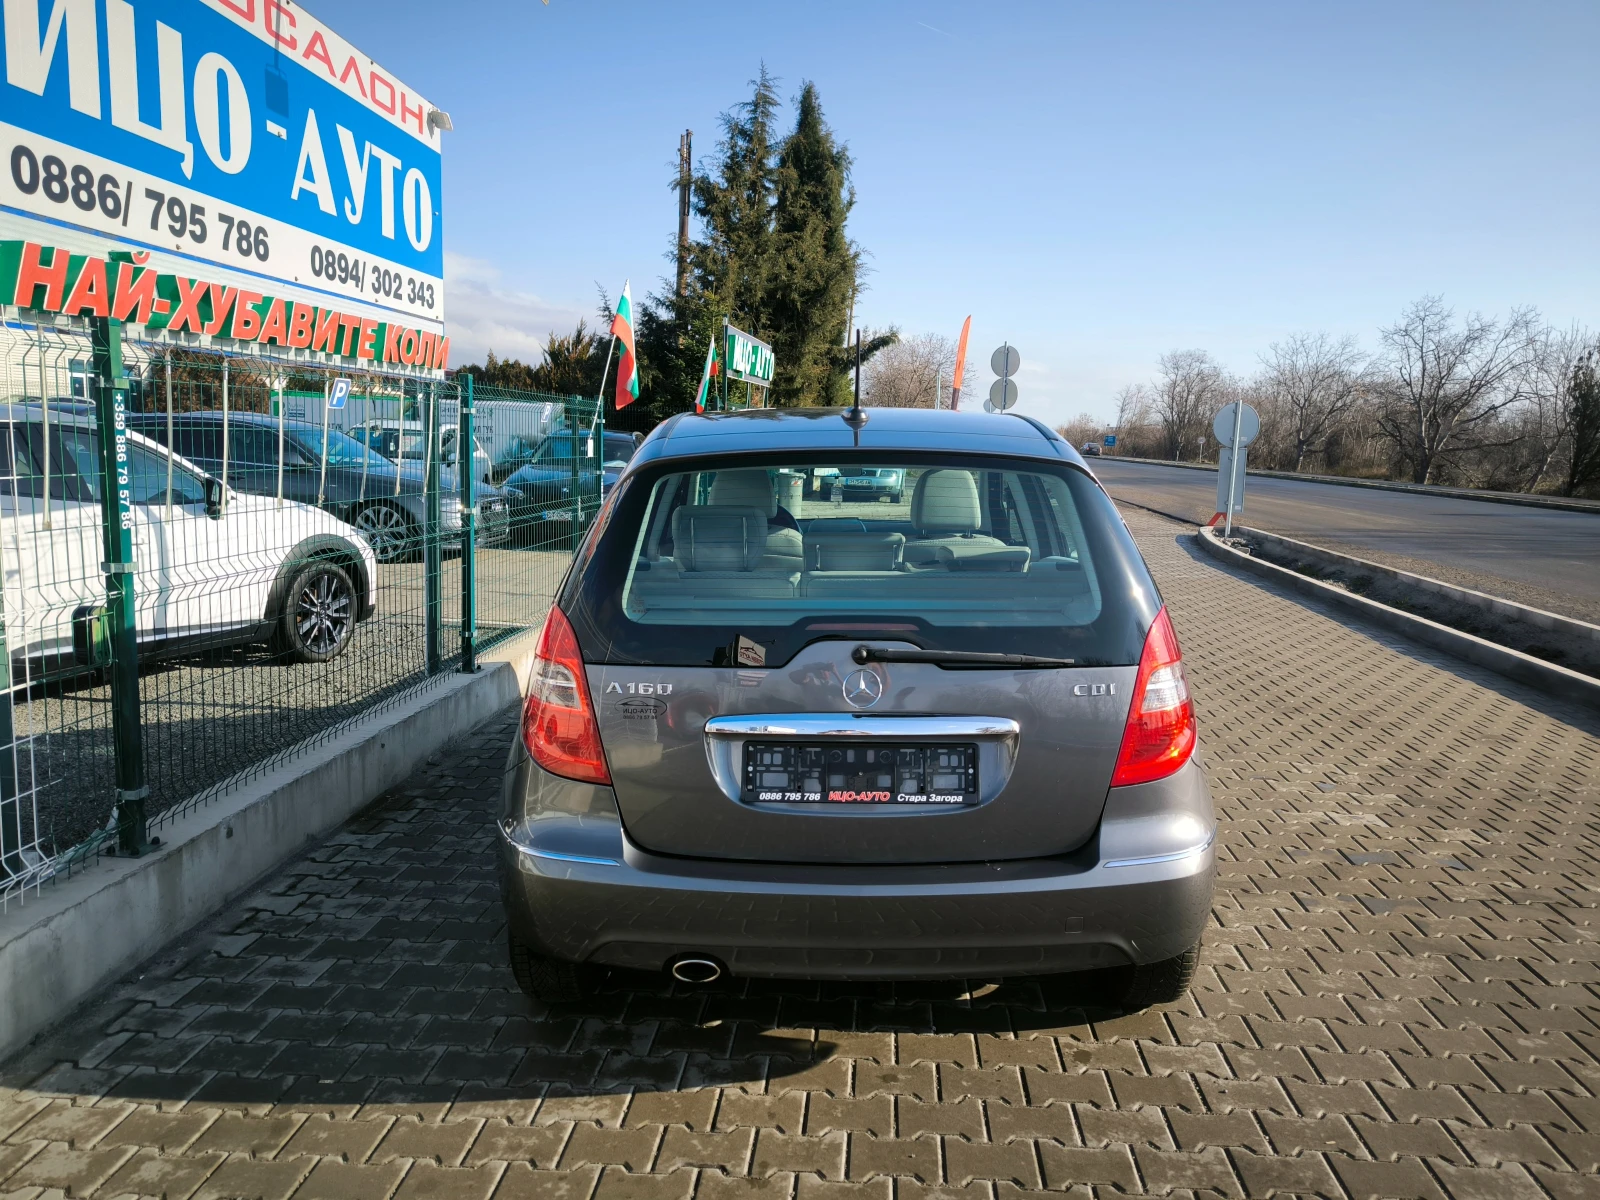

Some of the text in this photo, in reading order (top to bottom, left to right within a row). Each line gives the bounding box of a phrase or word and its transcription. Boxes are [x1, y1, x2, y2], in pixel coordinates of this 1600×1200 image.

[11, 145, 269, 262] 0886/ 795 786
[310, 245, 435, 310] 0894/ 302 343
[14, 241, 450, 370] НАЙ-ХУБАВИТЕ КОЛИ
[733, 334, 775, 381] ИЦО-АУТО
[333, 382, 347, 404] P
[114, 393, 131, 529] +359 886 79 57 86
[1073, 683, 1116, 696] CDI
[759, 792, 821, 801] 0886 795 786
[828, 791, 891, 802] ИЦО-АУТО
[897, 794, 963, 803] Стара Загора
